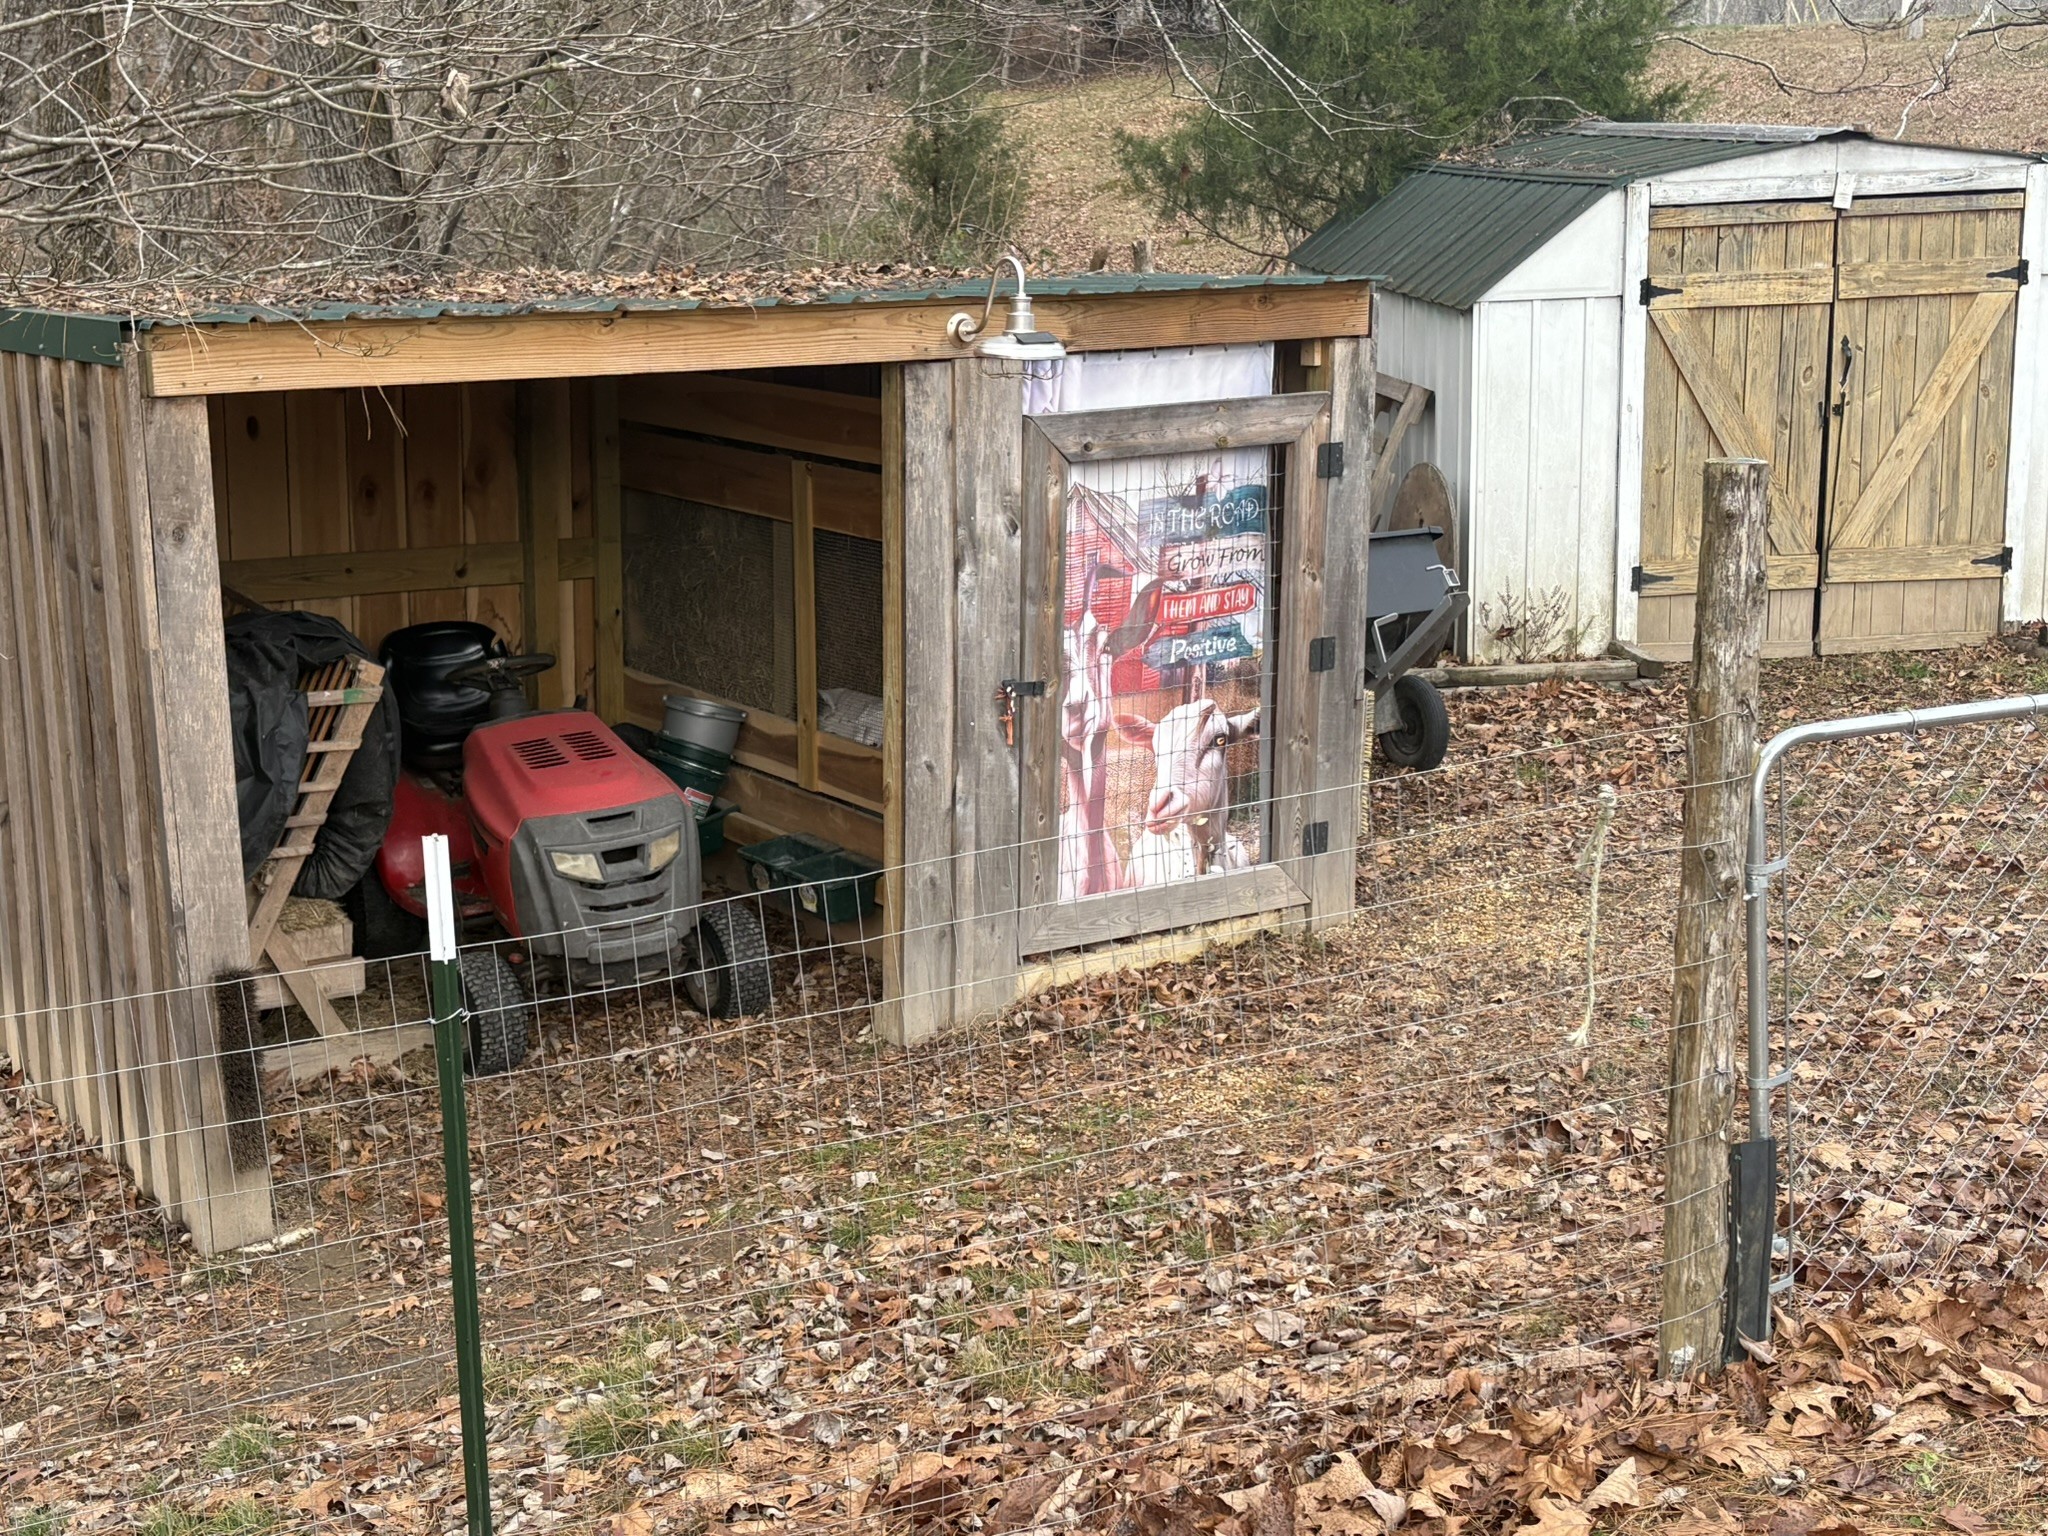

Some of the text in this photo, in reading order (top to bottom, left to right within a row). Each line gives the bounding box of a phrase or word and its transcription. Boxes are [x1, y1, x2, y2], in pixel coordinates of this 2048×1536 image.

[1209, 498, 1259, 529] ROAD
[1167, 547, 1265, 574] Grow From
[1163, 587, 1250, 619] THEM AND STAY
[1169, 636, 1237, 663] Positive
